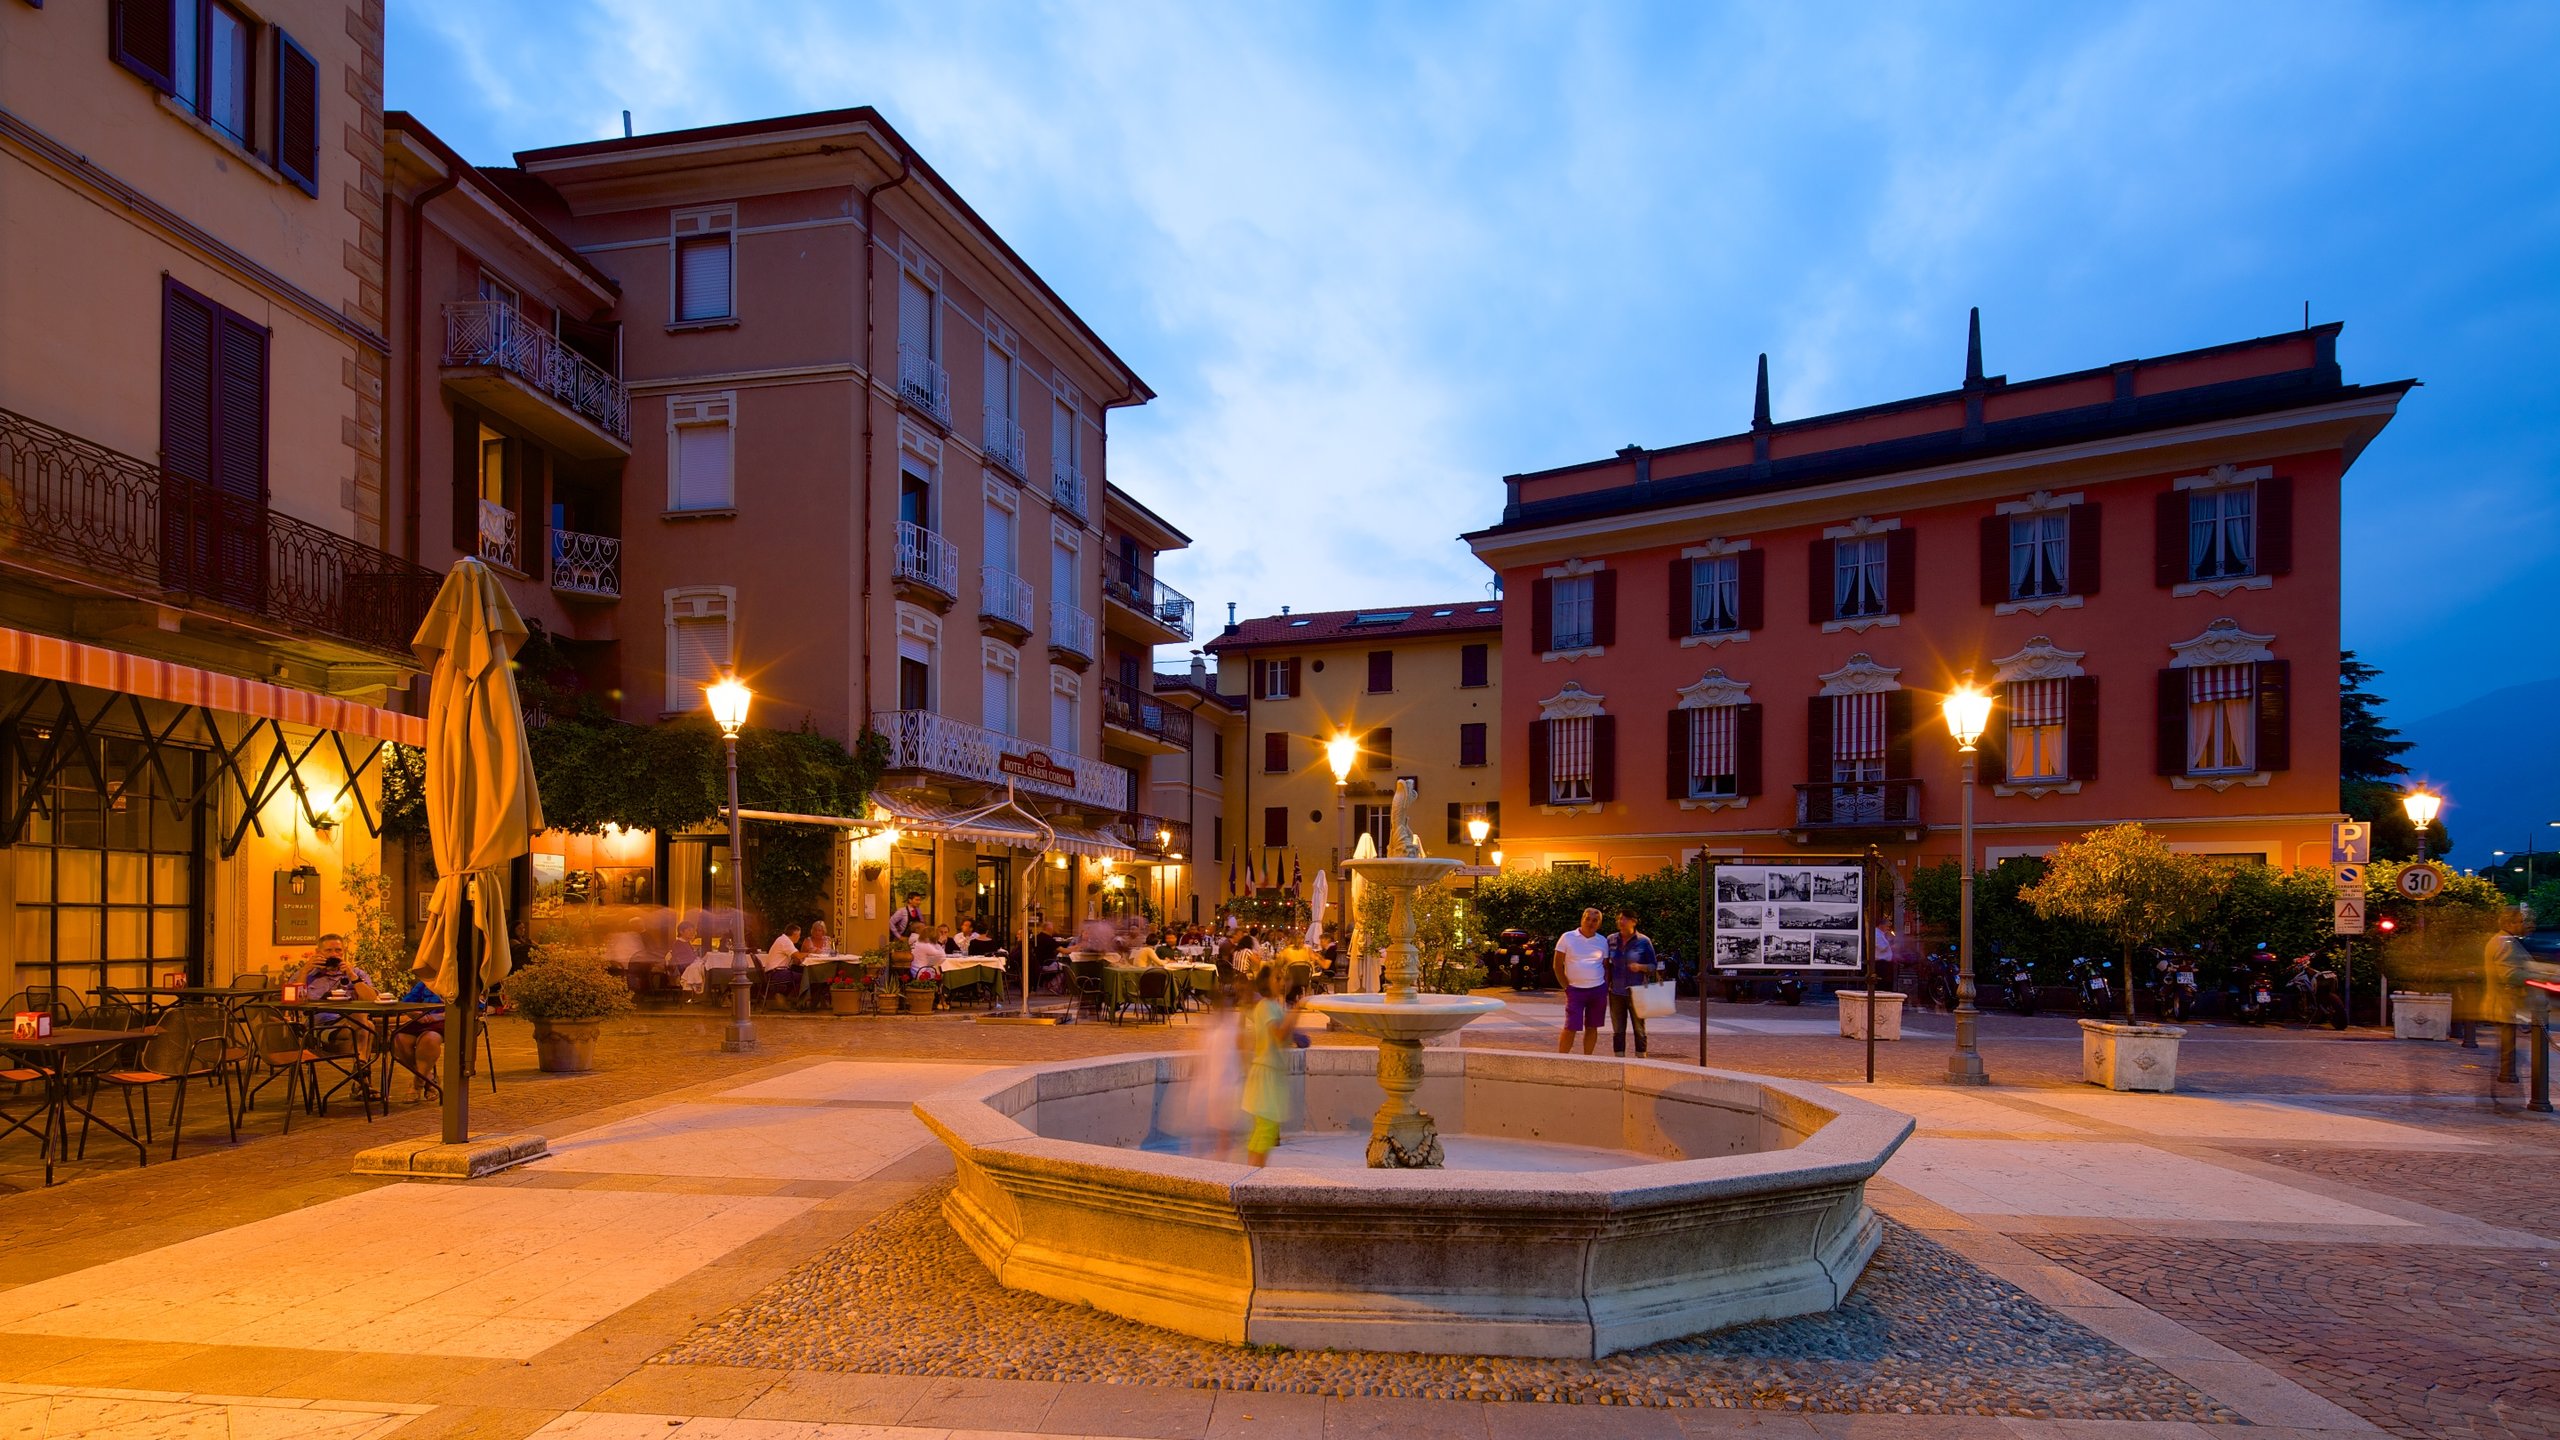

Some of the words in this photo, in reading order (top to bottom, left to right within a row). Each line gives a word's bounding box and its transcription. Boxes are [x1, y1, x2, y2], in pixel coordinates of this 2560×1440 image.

[1004, 760, 1026, 774] HOTEL
[1027, 766, 1048, 780] GARNI
[1049, 771, 1072, 786] CORONA
[2338, 824, 2362, 849] P
[2408, 873, 2431, 891] 30
[836, 848, 844, 945] RISTORANTE
